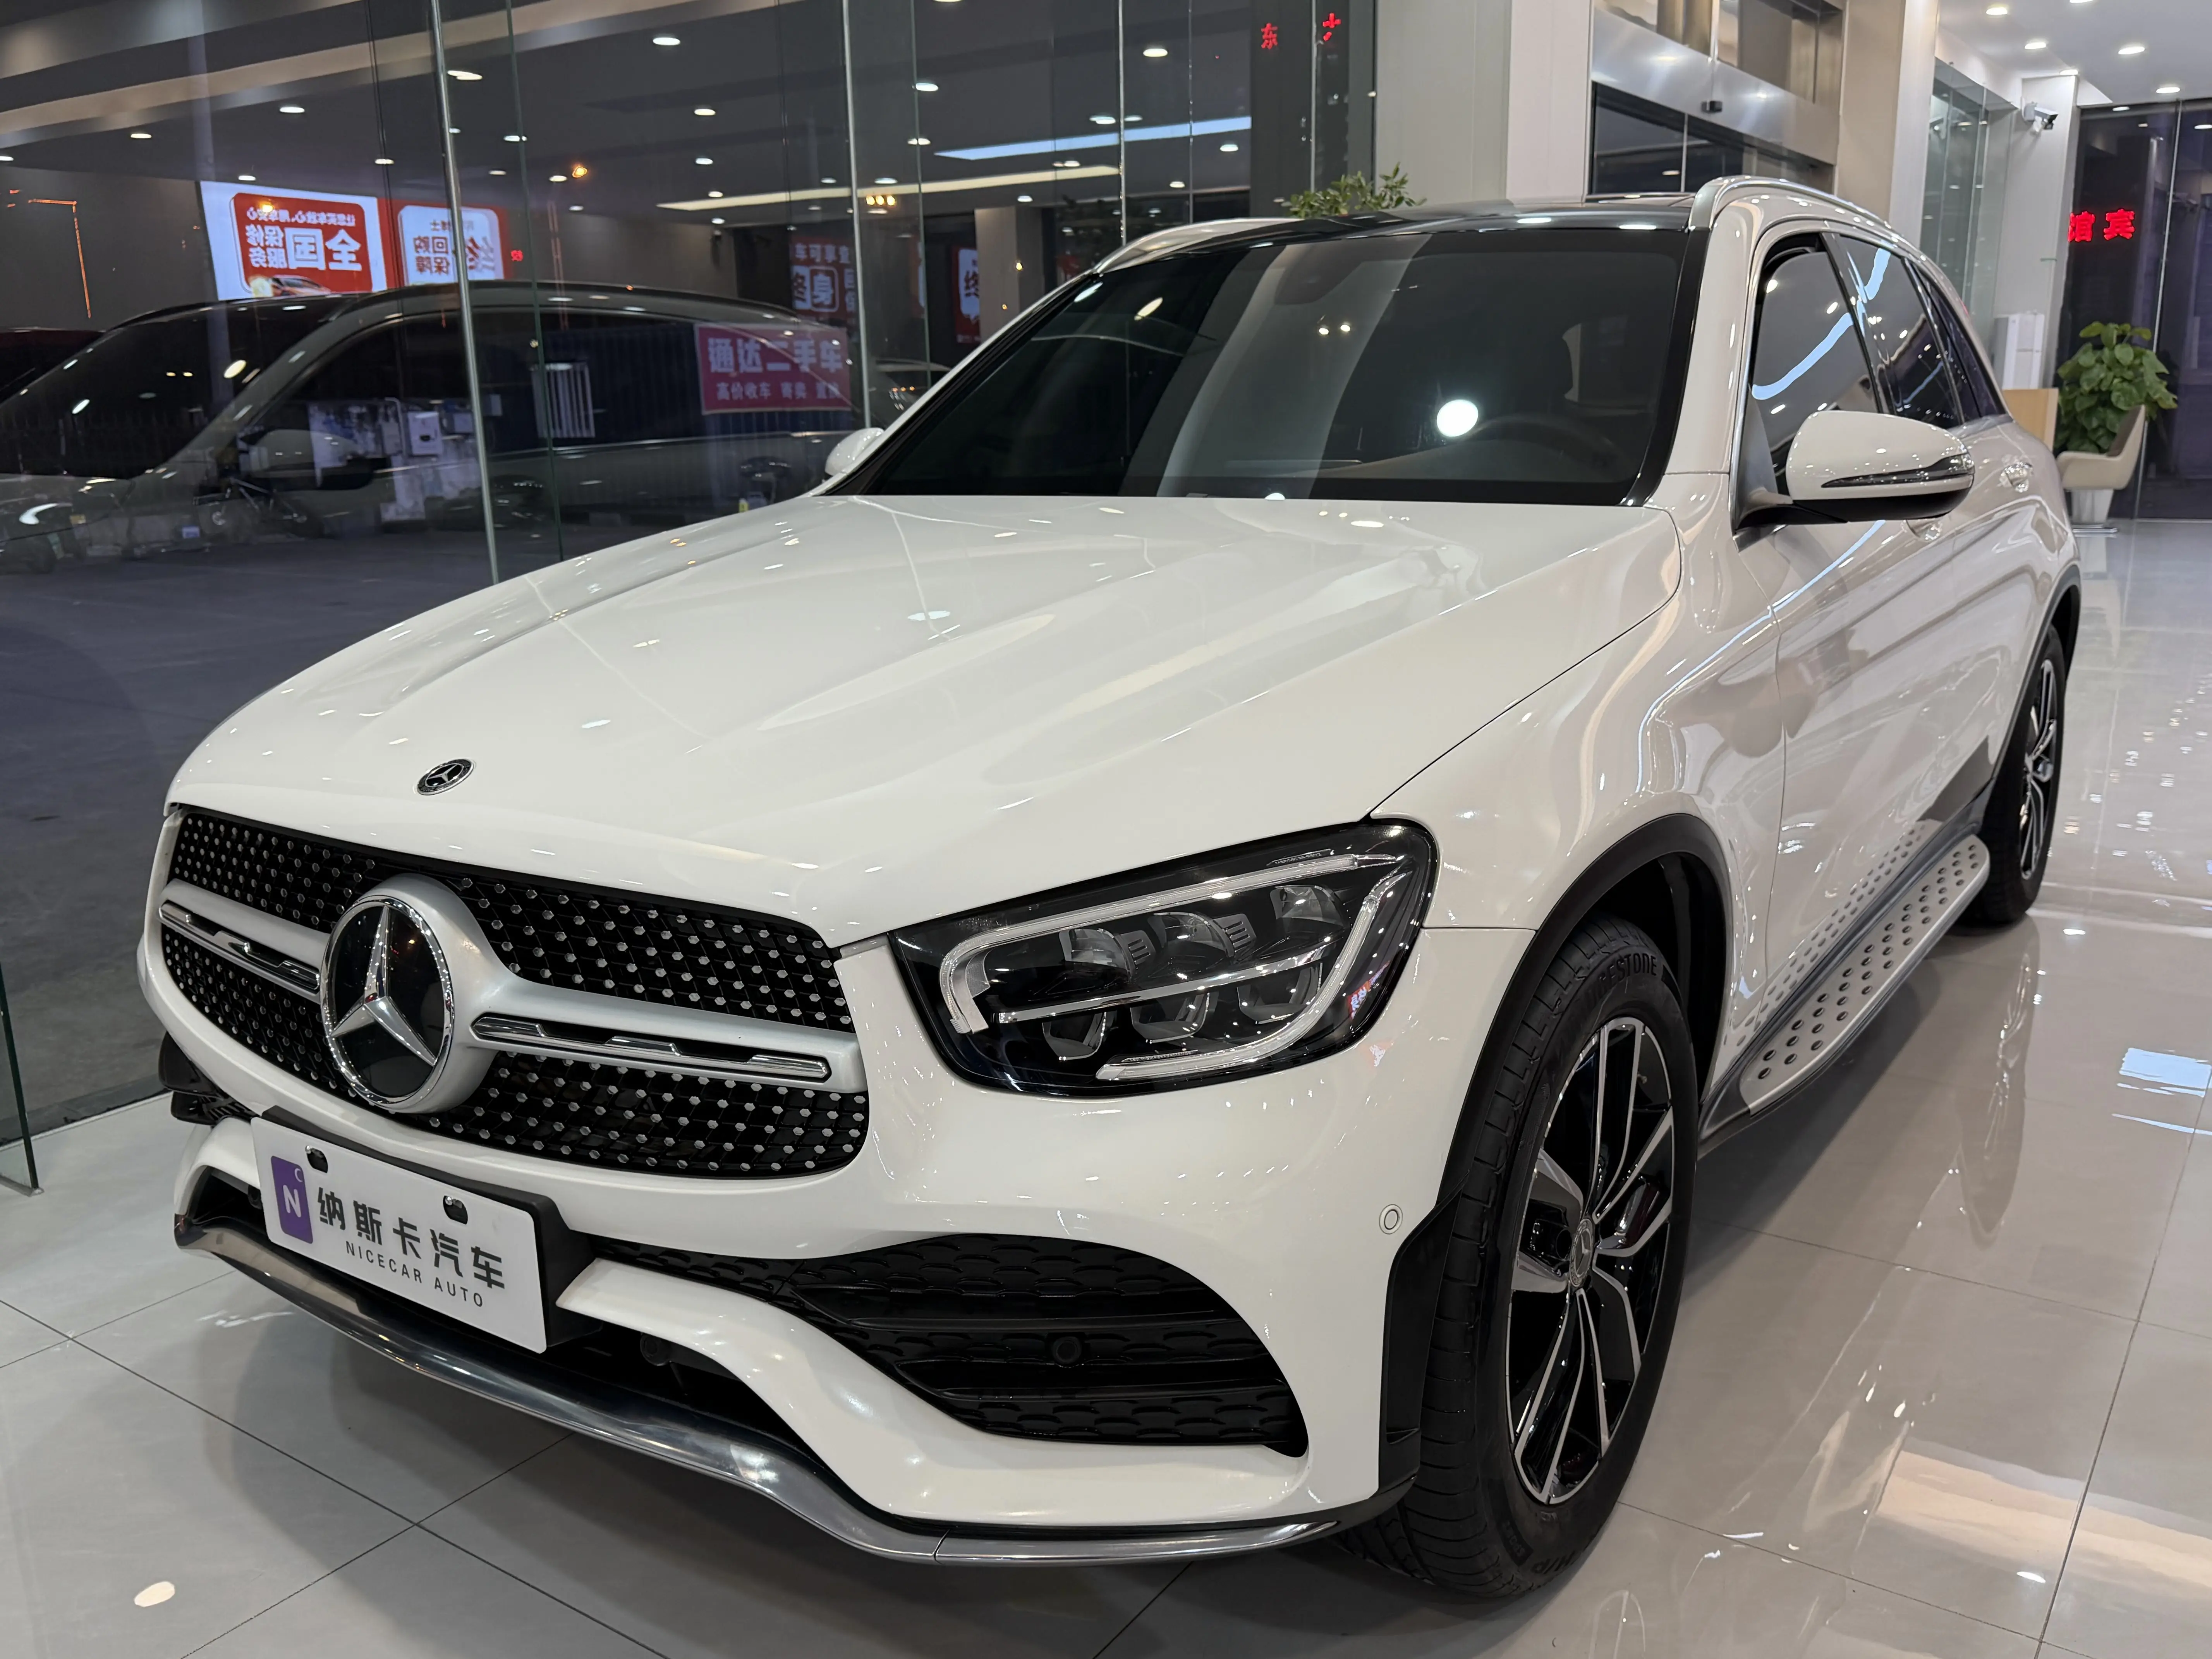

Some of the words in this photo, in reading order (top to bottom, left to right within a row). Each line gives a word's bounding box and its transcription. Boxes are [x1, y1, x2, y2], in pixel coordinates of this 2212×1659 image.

[708, 338, 843, 373] 通达二手车
[317, 1187, 505, 1290] 纳斯卡汽车
[345, 1240, 422, 1284] NICECAR
[434, 1276, 483, 1308] AUTO
